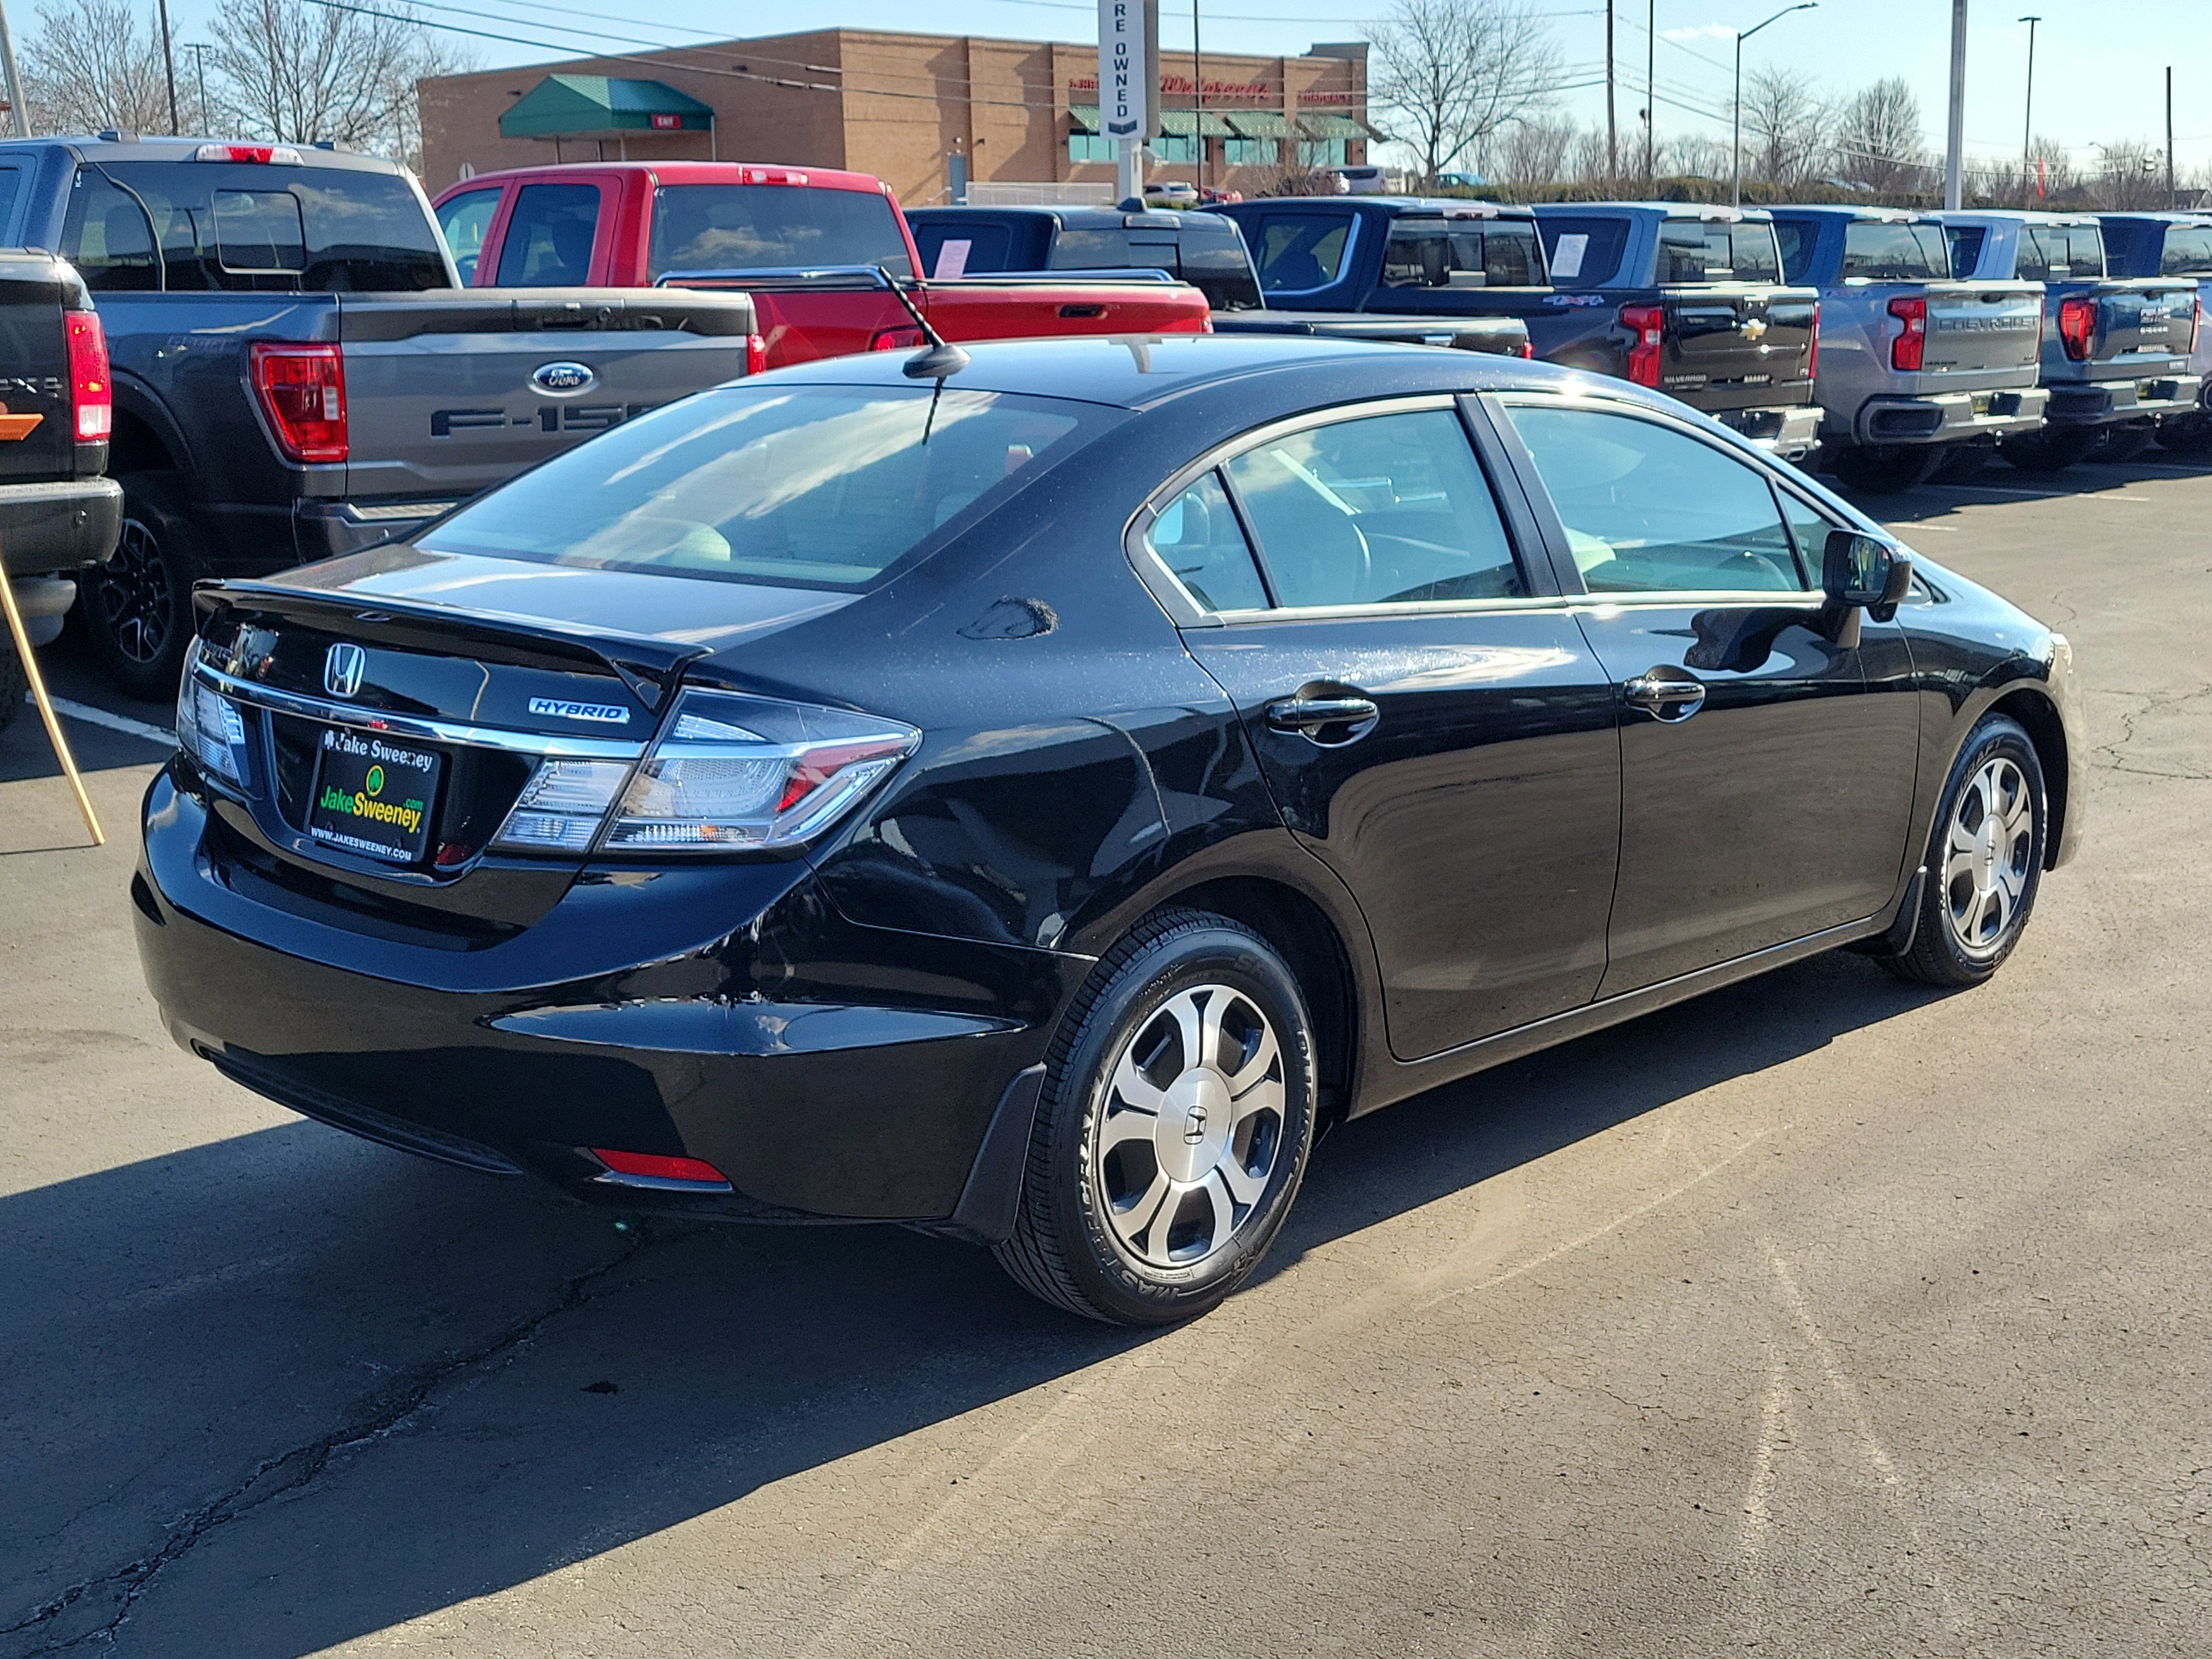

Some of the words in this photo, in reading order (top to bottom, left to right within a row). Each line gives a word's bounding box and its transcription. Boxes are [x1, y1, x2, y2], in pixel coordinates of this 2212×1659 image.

[1114, 0, 1126, 32] RE
[1114, 42, 1129, 117] OWNED
[1938, 314, 2038, 332] CHEVROLET
[549, 368, 580, 386] Ford
[534, 701, 623, 719] HYBRID
[336, 732, 368, 755] Jake
[370, 740, 433, 772] Sweeney
[311, 826, 413, 860] WWW.JAKESWEENEY.COM
